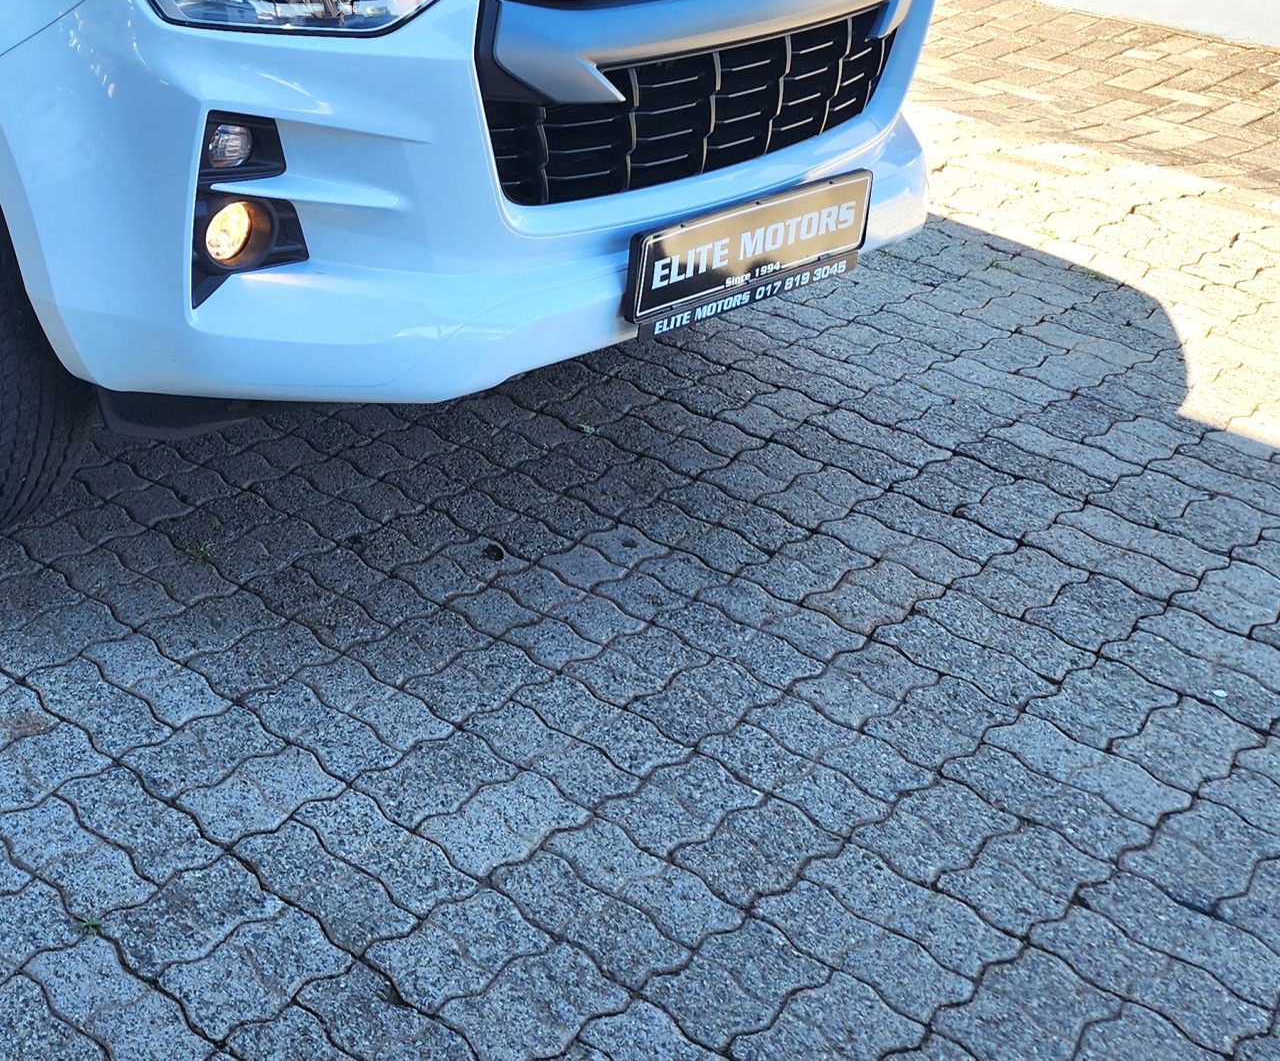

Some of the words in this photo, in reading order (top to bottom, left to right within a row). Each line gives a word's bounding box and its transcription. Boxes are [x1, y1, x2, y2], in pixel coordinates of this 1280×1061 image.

[651, 237, 730, 290] ELITE
[739, 200, 856, 261] MOTORS
[725, 272, 751, 289] Since
[755, 260, 781, 278] 1994
[653, 310, 691, 335] ELITE
[694, 290, 750, 322] MOTORS
[755, 282, 781, 301] 017
[784, 272, 809, 291] 819
[812, 259, 847, 283] 3045
